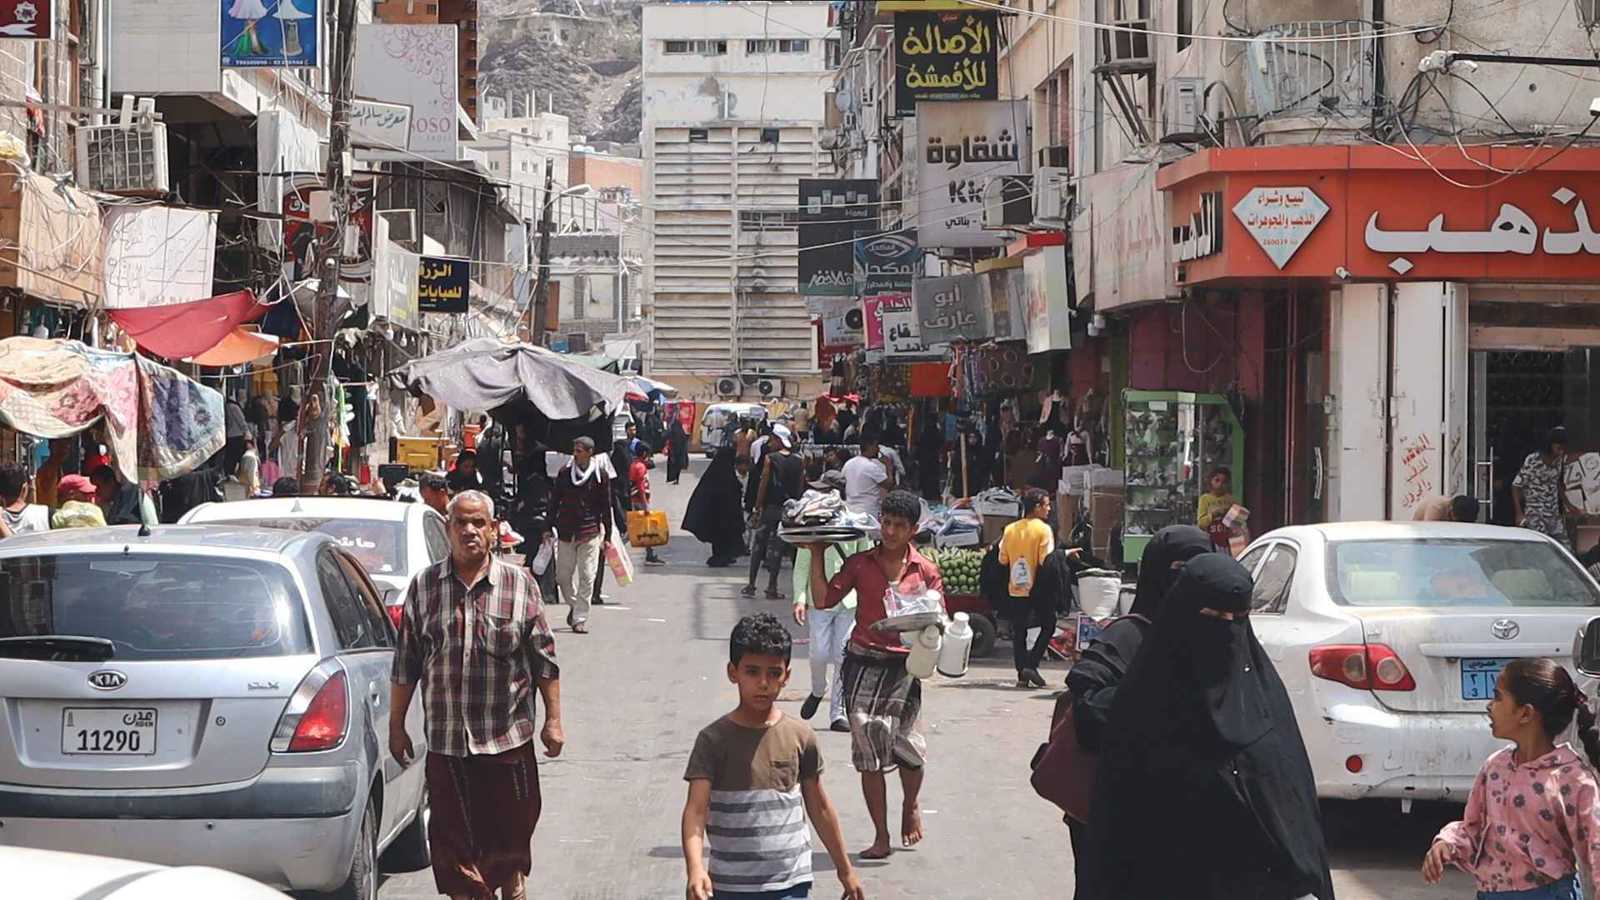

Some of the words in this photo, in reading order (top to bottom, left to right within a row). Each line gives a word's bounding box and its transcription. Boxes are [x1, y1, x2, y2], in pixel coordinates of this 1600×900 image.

[902, 16, 991, 55] الأصالة
[411, 116, 451, 133] OSO
[926, 129, 1018, 170] شقاوة
[1364, 187, 1600, 275] ذهب
[95, 674, 119, 687] KIA
[123, 712, 153, 725] عدن
[77, 729, 140, 751] 11290
